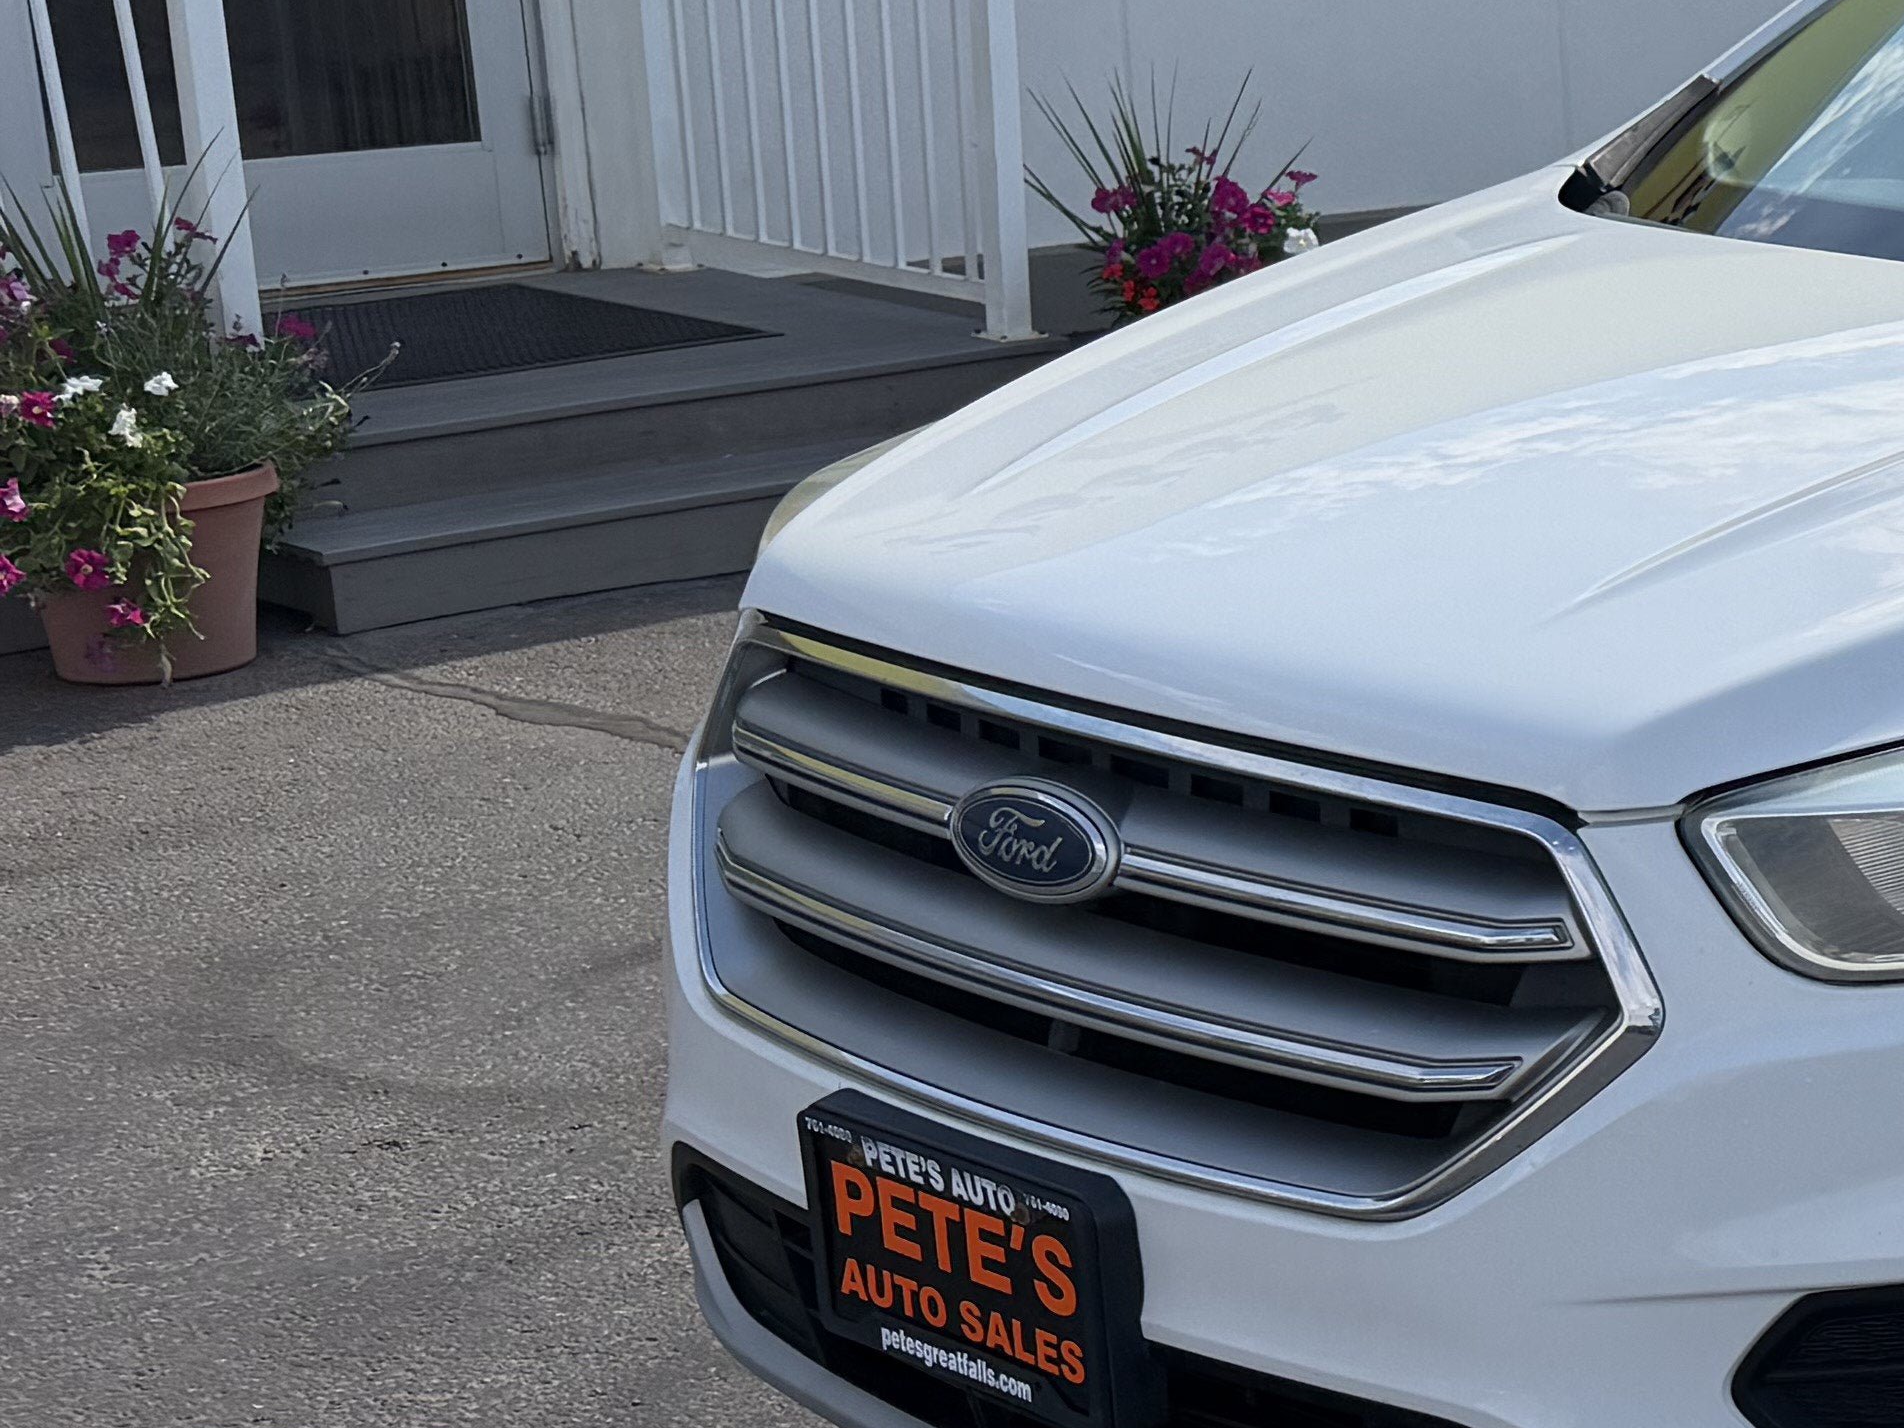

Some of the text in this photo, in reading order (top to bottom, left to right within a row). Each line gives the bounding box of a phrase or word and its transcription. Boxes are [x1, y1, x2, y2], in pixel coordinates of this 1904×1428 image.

[978, 806, 1063, 873] Ford
[860, 1136, 945, 1192] PETE'S
[951, 1167, 1016, 1217] AUTO
[830, 1159, 1077, 1317] PETE'S
[840, 1258, 1085, 1384] AUTO SALES
[881, 1326, 1032, 1403] petesgreatfalls.com
